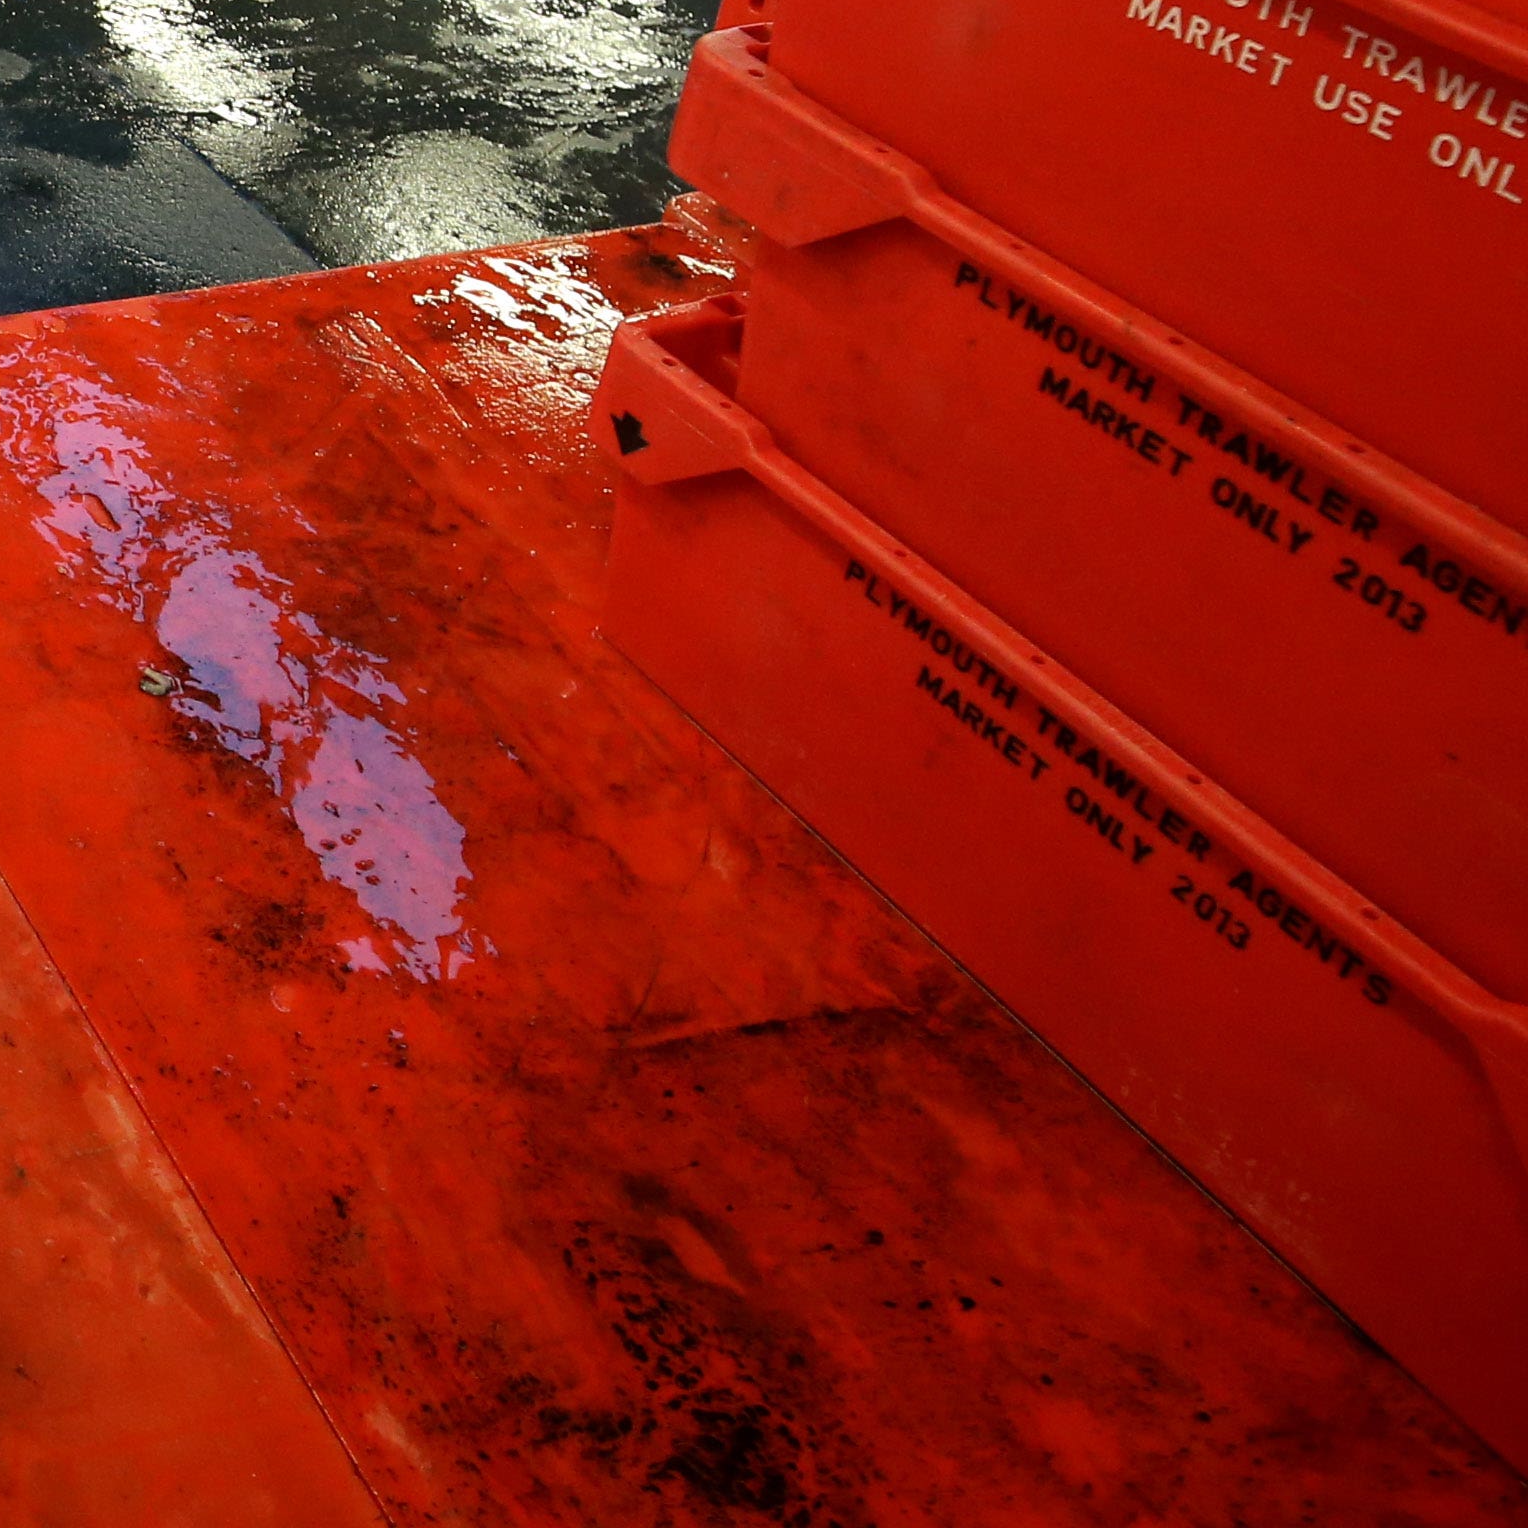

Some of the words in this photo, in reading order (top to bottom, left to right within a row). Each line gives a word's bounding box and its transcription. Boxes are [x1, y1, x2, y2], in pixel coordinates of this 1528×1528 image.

[1313, 74, 1404, 141] USE
[1428, 131, 1528, 205] ONL
[1342, 23, 1528, 140] TRAWLE
[954, 260, 1156, 405] PLYMOUTH
[1176, 393, 1382, 542] TRAWLER
[1400, 542, 1528, 640] AGEN
[1038, 367, 1194, 478] MARKET
[1211, 478, 1314, 557] ONLY
[1333, 557, 1430, 636] 2013
[843, 557, 1019, 710] PLYMOUTH
[1035, 707, 1213, 863] TRAWLER
[1229, 868, 1394, 1008] AGENTS
[916, 663, 1049, 782] MARKET
[1065, 784, 1156, 866] ONLY
[1169, 874, 1254, 953] 2013
